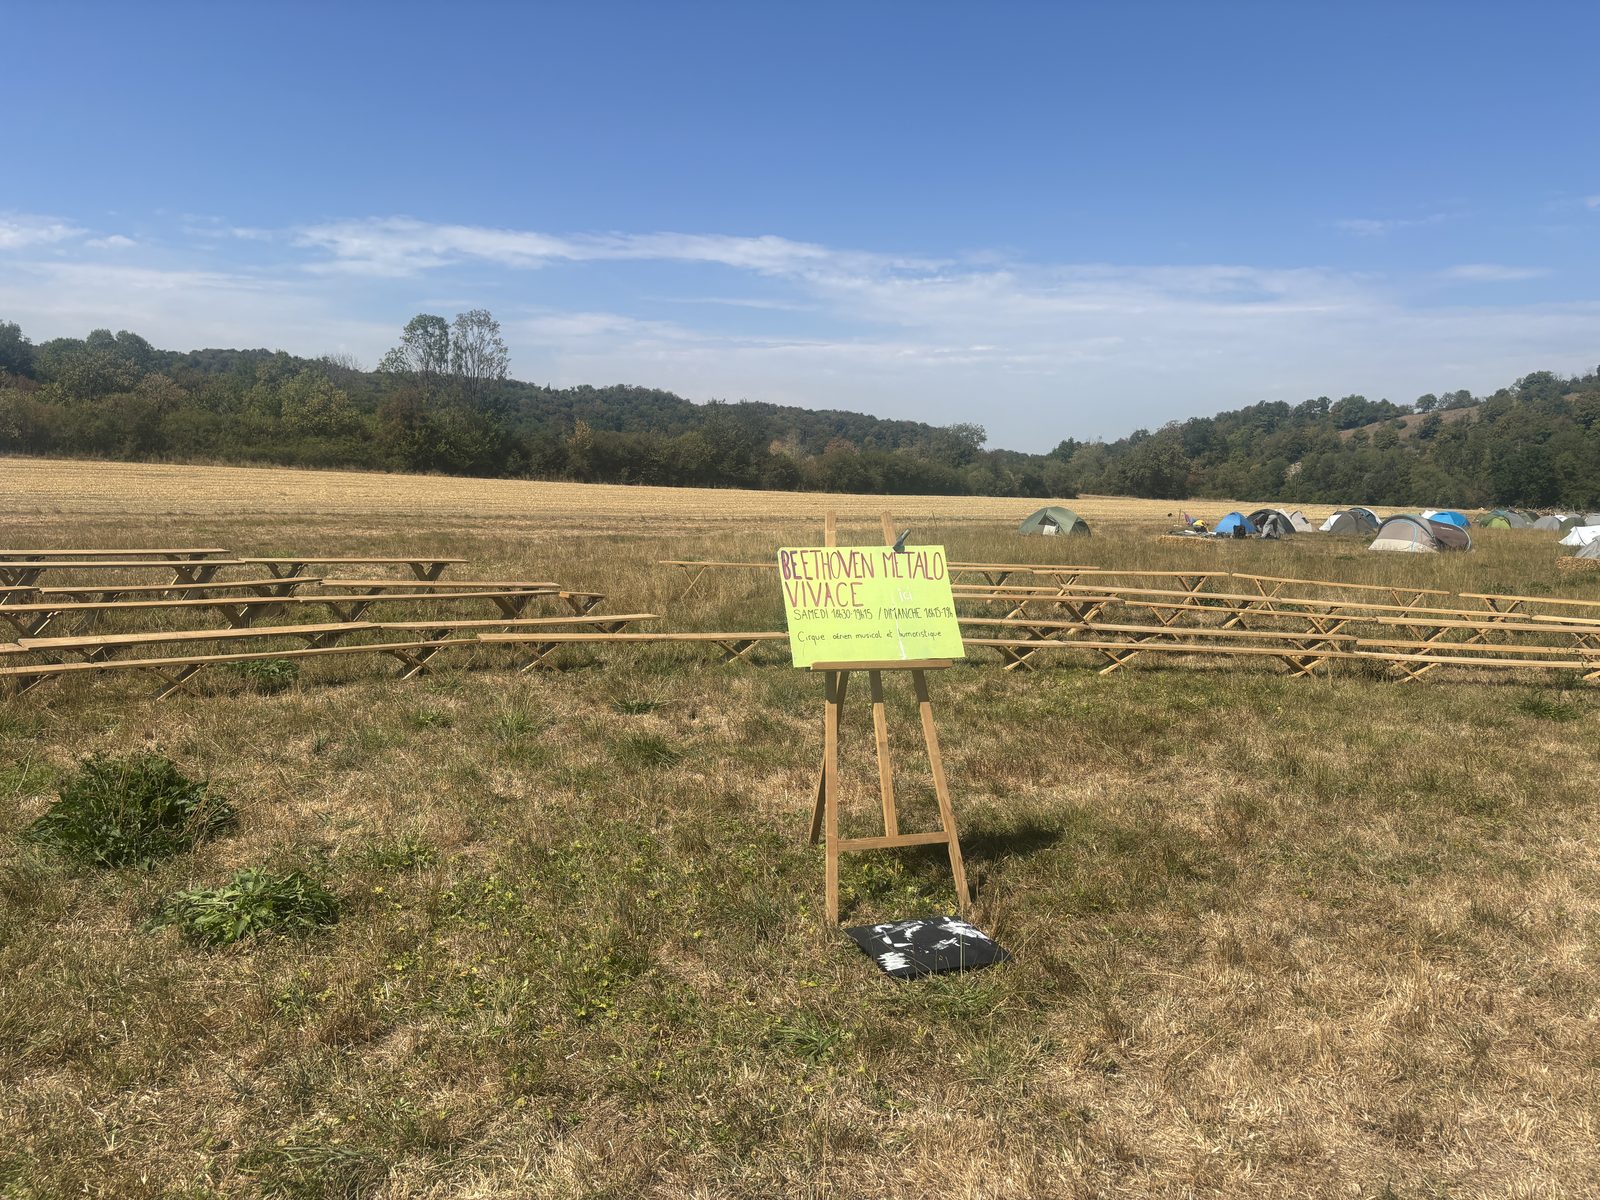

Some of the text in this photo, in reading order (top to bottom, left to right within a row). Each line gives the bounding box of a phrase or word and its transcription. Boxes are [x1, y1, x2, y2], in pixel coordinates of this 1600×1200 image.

[781, 549, 945, 581] BEETHOVEN METALO
[785, 581, 864, 608] VIVACE
[793, 608, 829, 620] SAMEDI
[884, 607, 922, 620] DIMANCHE
[797, 631, 826, 646] Cirque
[855, 630, 882, 640] musical
[886, 629, 893, 639] et
[898, 628, 942, 640] humoristique
